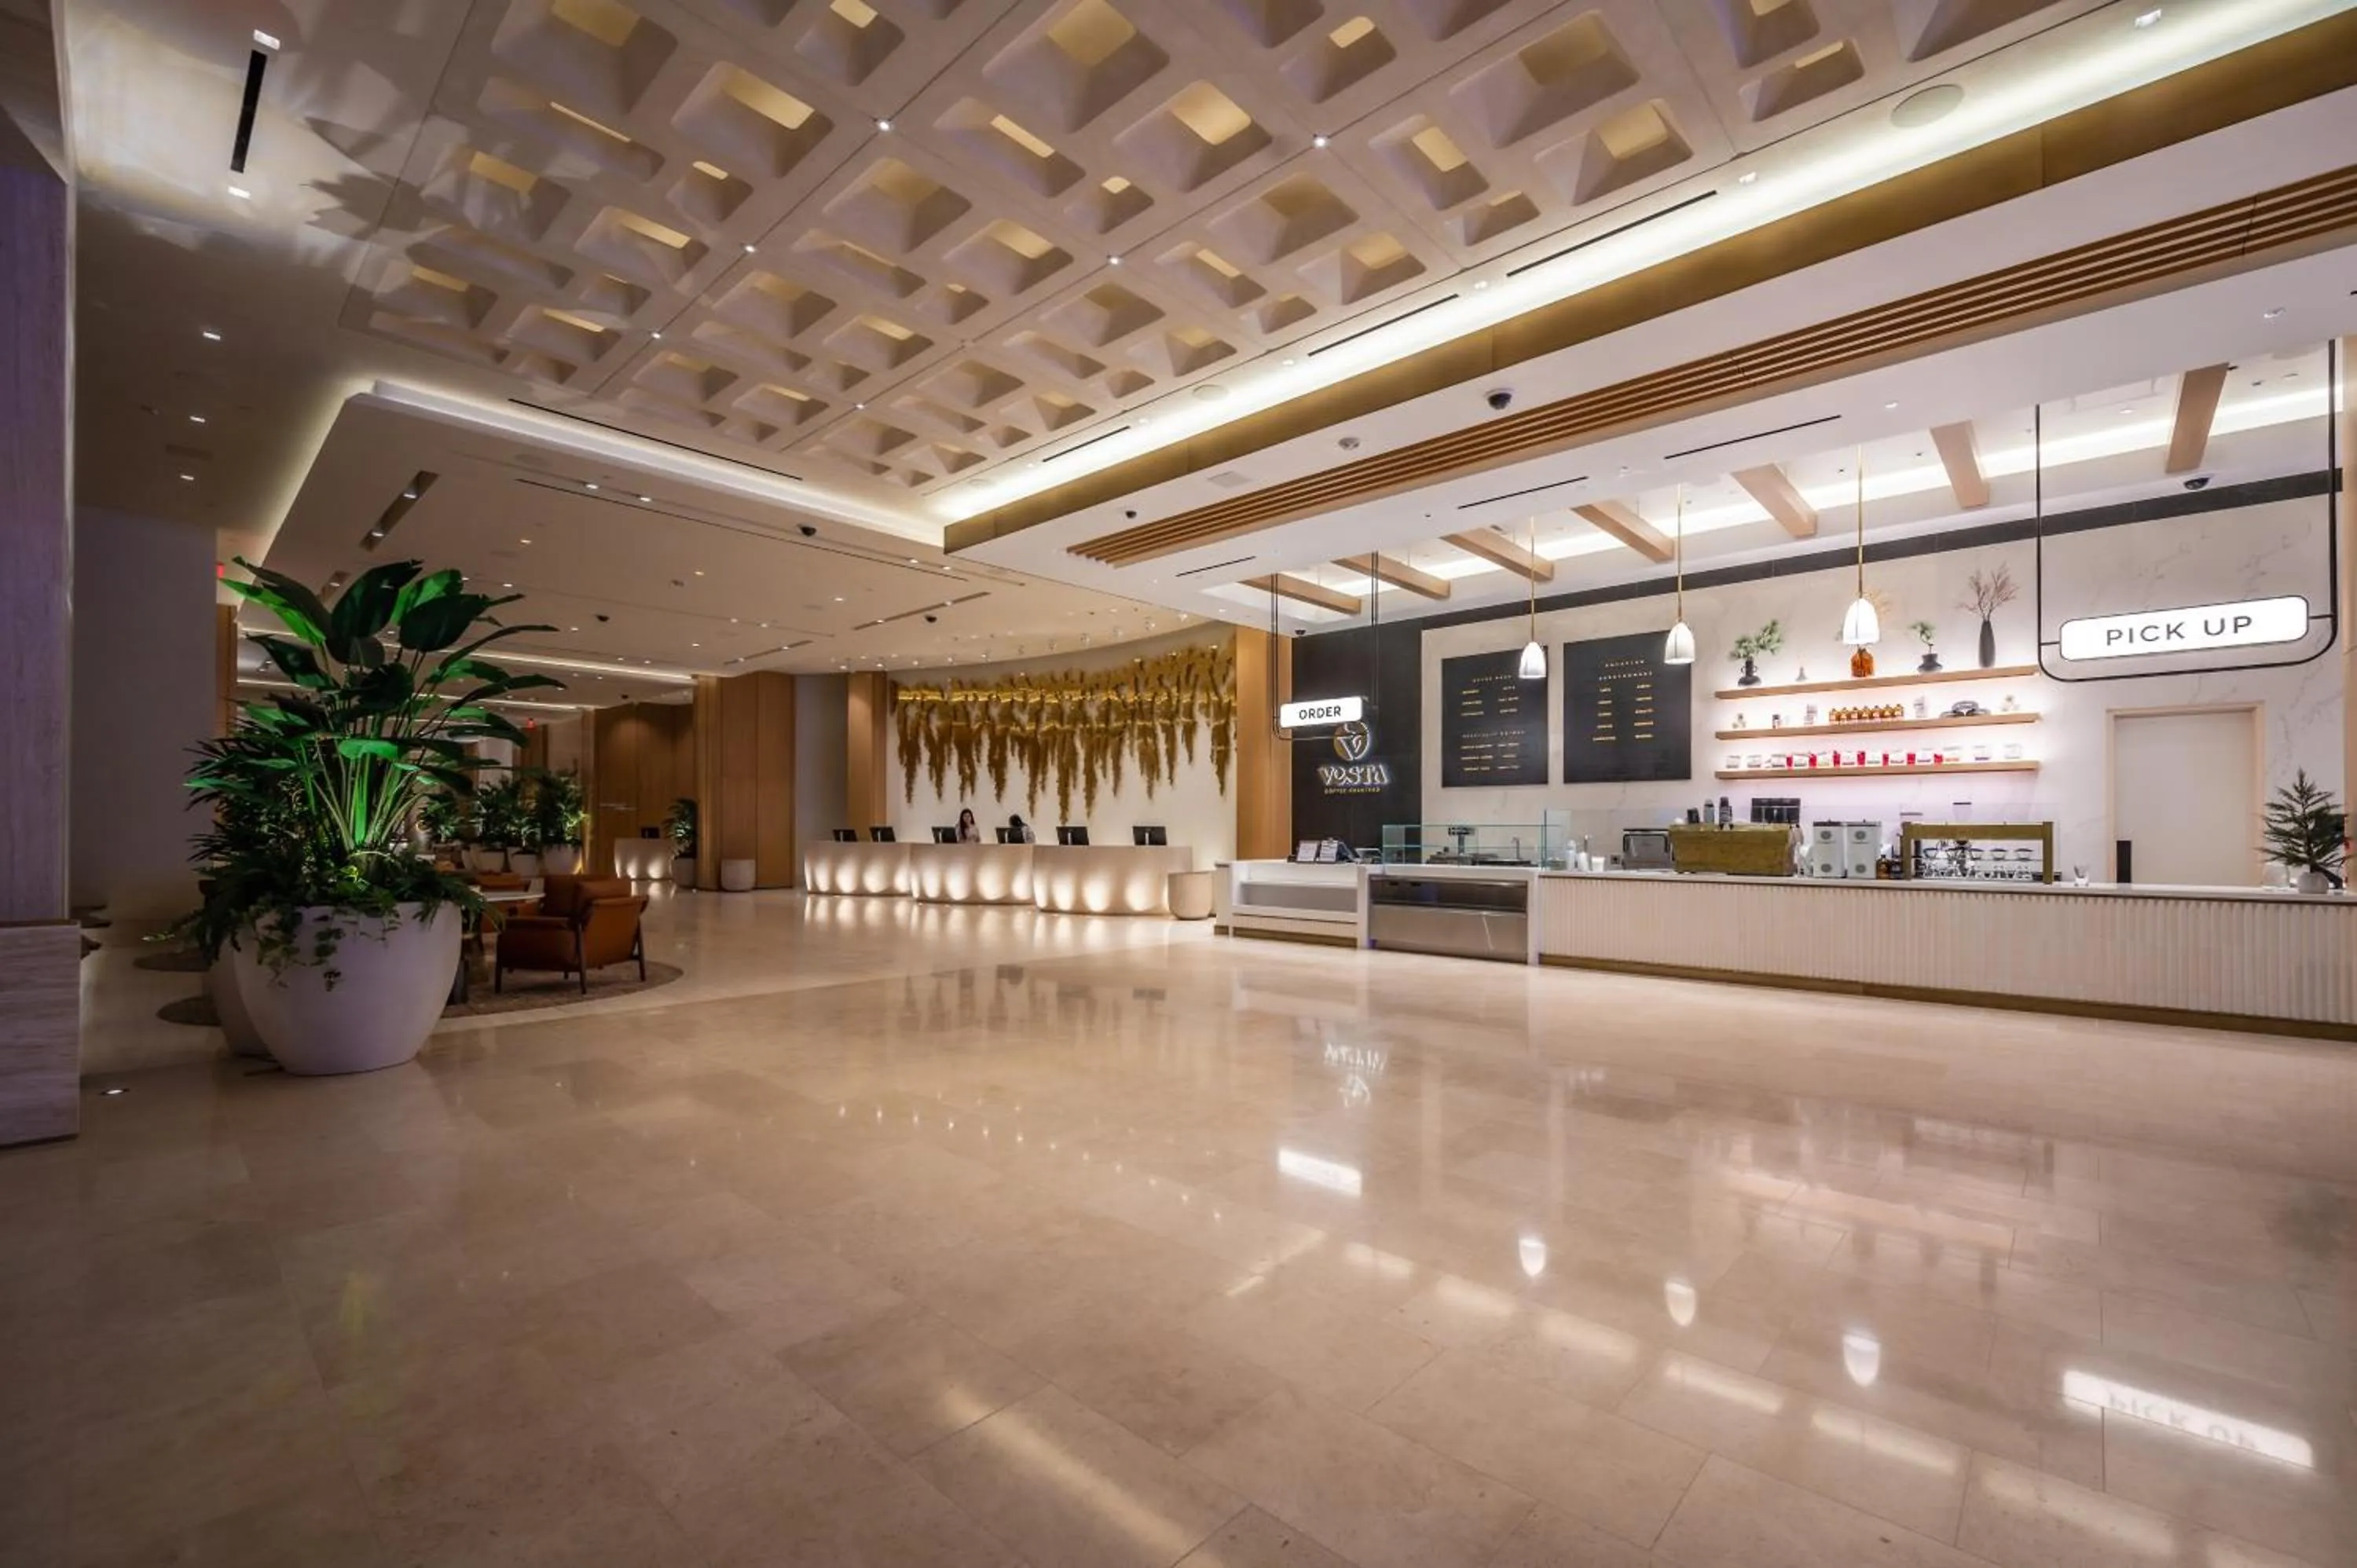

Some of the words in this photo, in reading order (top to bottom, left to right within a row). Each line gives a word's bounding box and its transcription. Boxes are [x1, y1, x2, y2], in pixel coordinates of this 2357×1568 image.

[2106, 622, 2185, 646] PICK
[2204, 616, 2253, 636] UP
[1299, 705, 1341, 720] ORDER
